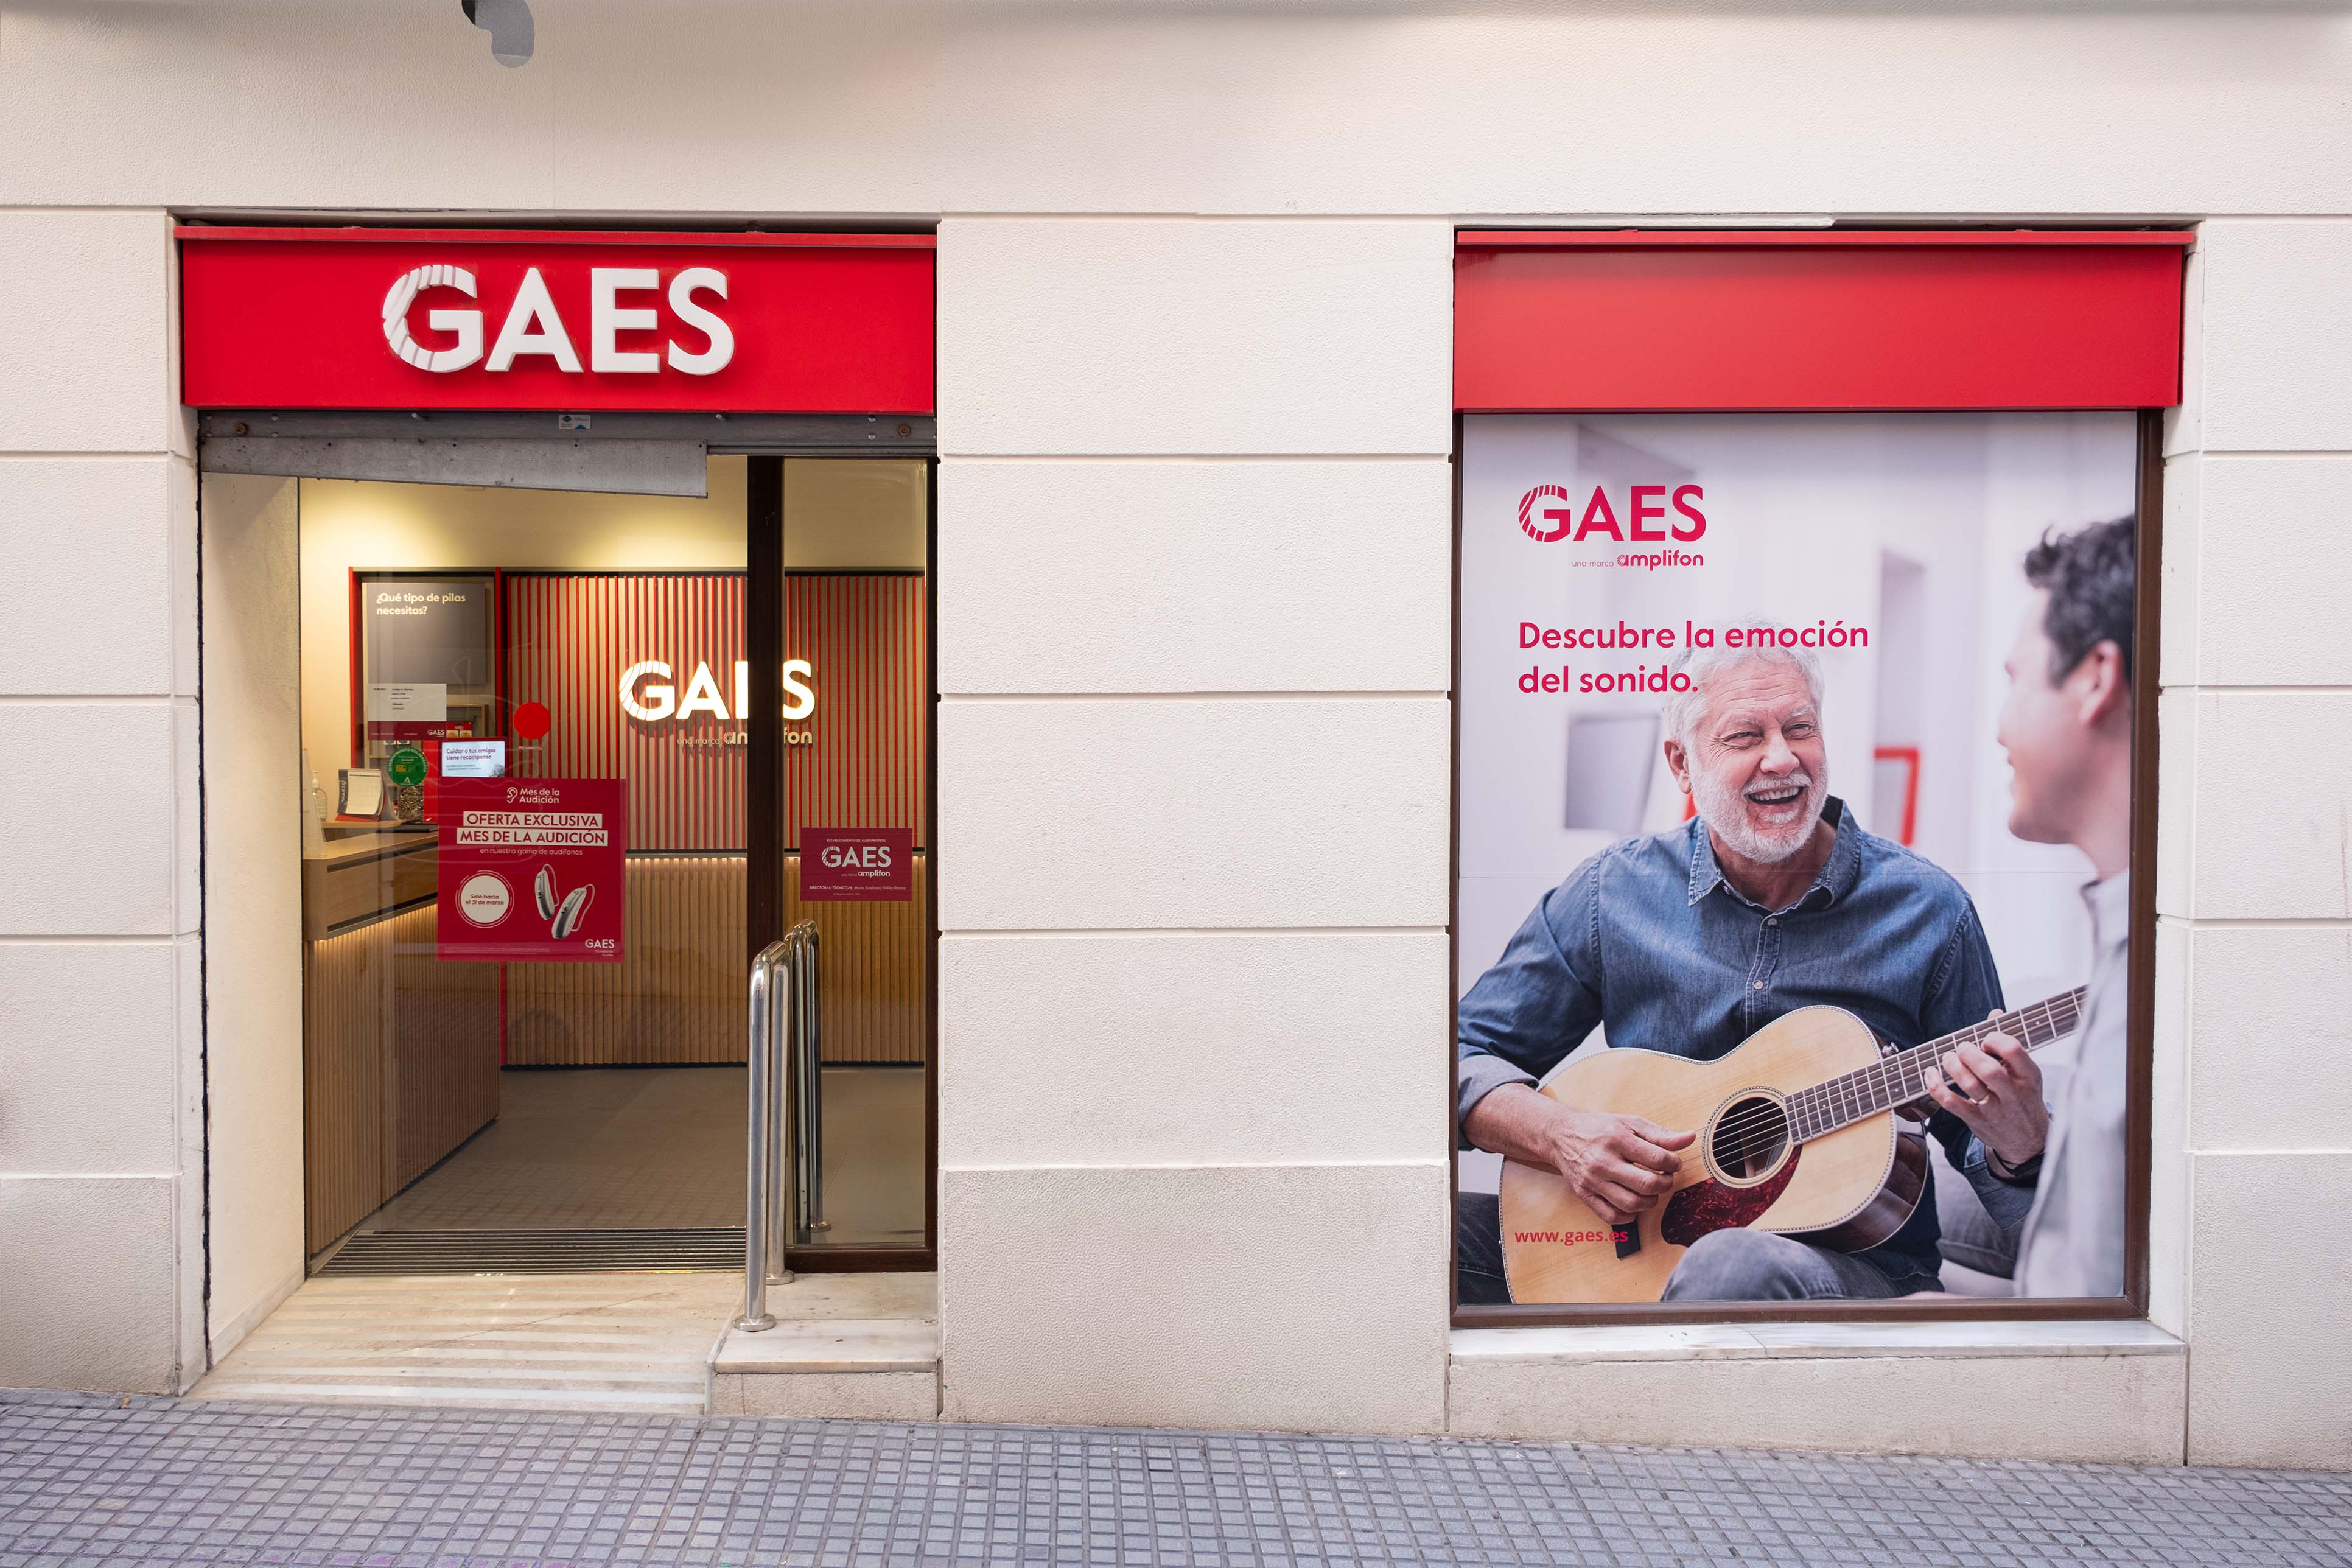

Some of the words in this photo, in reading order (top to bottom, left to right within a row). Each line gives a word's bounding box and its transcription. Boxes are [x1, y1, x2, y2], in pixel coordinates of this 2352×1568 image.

[382, 264, 735, 376] GAES
[1518, 485, 1706, 542] GAES
[1617, 550, 1704, 571] amplifon
[376, 593, 402, 604] ¿Qué
[403, 593, 424, 604] tipo
[426, 593, 439, 602] de
[442, 593, 466, 604] pilas
[376, 606, 428, 615] necesitas?
[1519, 621, 1675, 649] Descubre
[1686, 621, 1713, 648] la
[1724, 620, 1868, 648] emoción
[1518, 665, 1569, 693] del
[1580, 665, 1698, 693] sonido.
[467, 813, 520, 825] OFERTA
[524, 814, 598, 827] EXCLUSIVA
[460, 831, 489, 842] MES
[493, 831, 509, 842] DE
[514, 831, 532, 842] LA
[536, 828, 604, 844] AUDICIÓN
[822, 846, 891, 867] GAES
[585, 939, 614, 948] GAES
[1514, 1231, 1629, 1246] www.gaes.es
